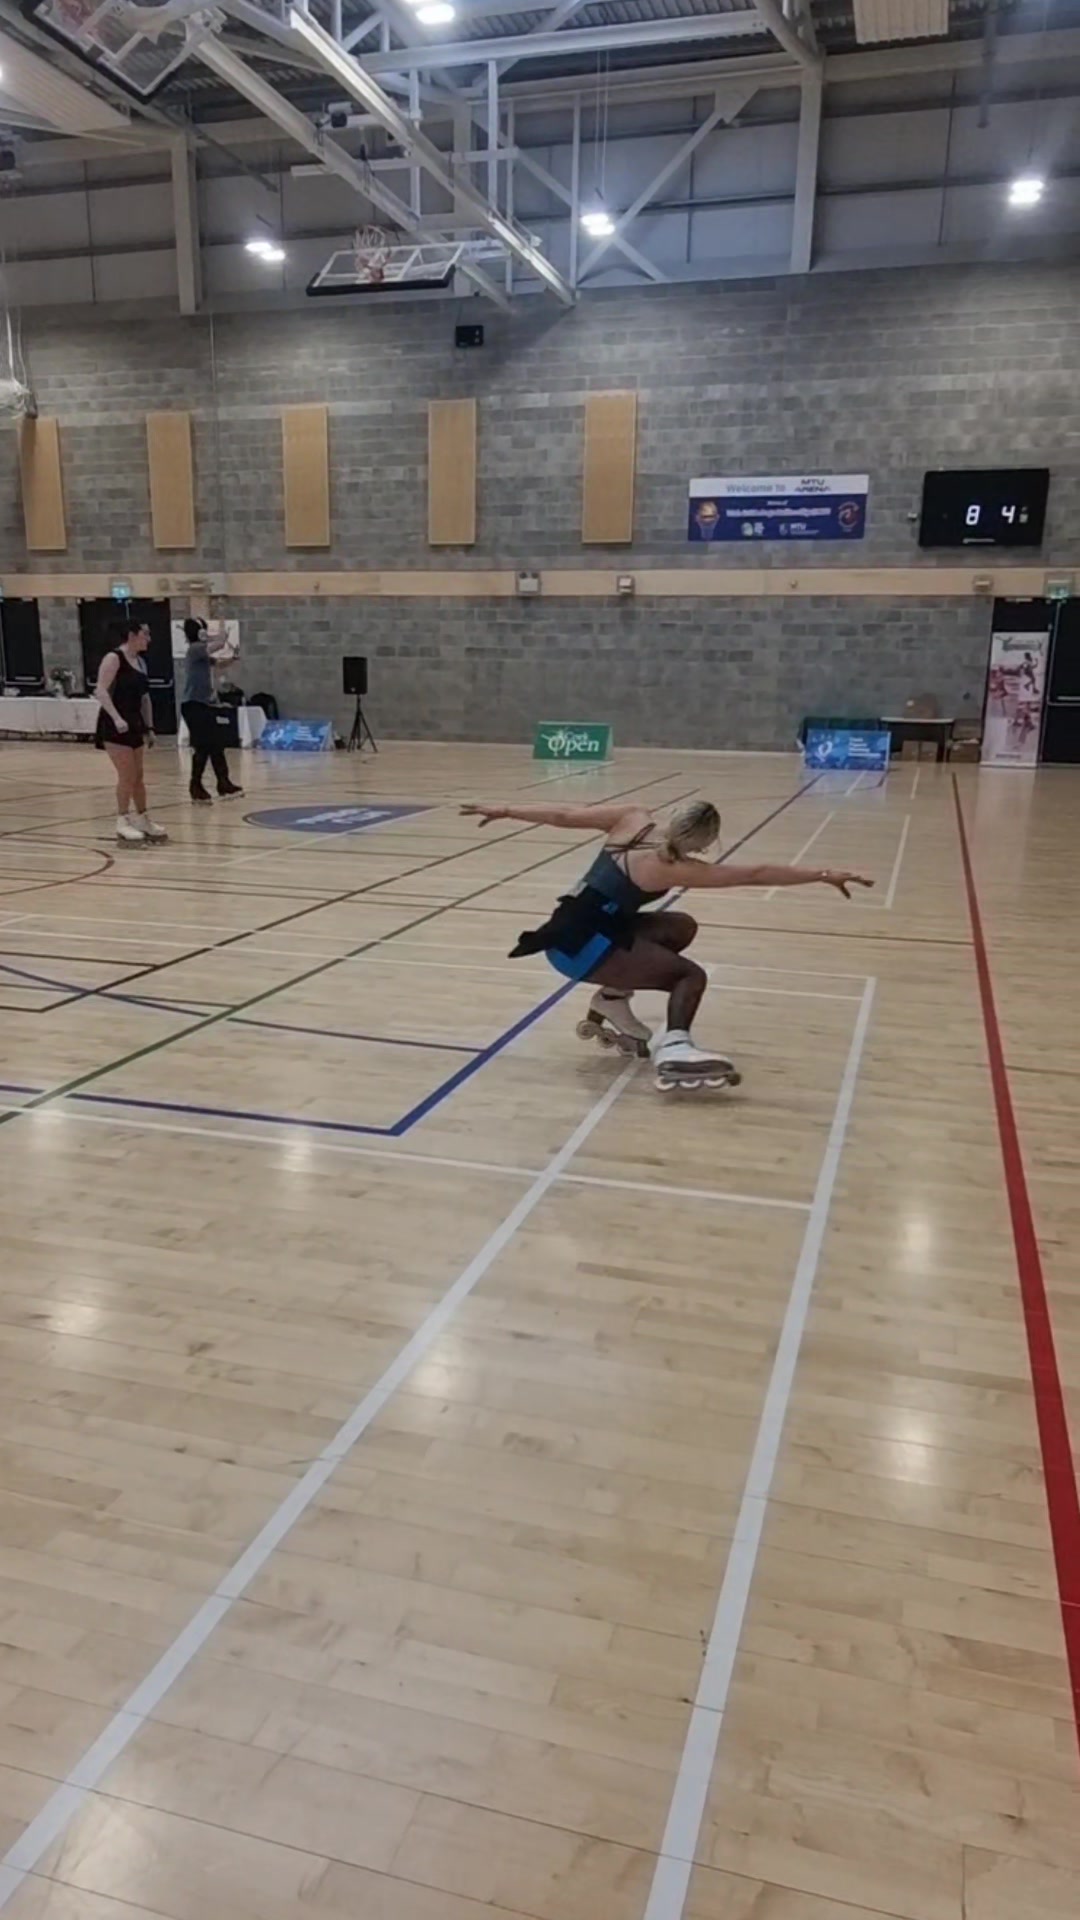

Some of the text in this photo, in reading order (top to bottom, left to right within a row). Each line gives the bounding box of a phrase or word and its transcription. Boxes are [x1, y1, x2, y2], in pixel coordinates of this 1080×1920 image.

[726, 483, 773, 493] Welcome
[801, 478, 825, 486] MTU
[965, 504, 981, 526] 8
[1001, 504, 1016, 524] 4
[547, 735, 600, 757] Open
